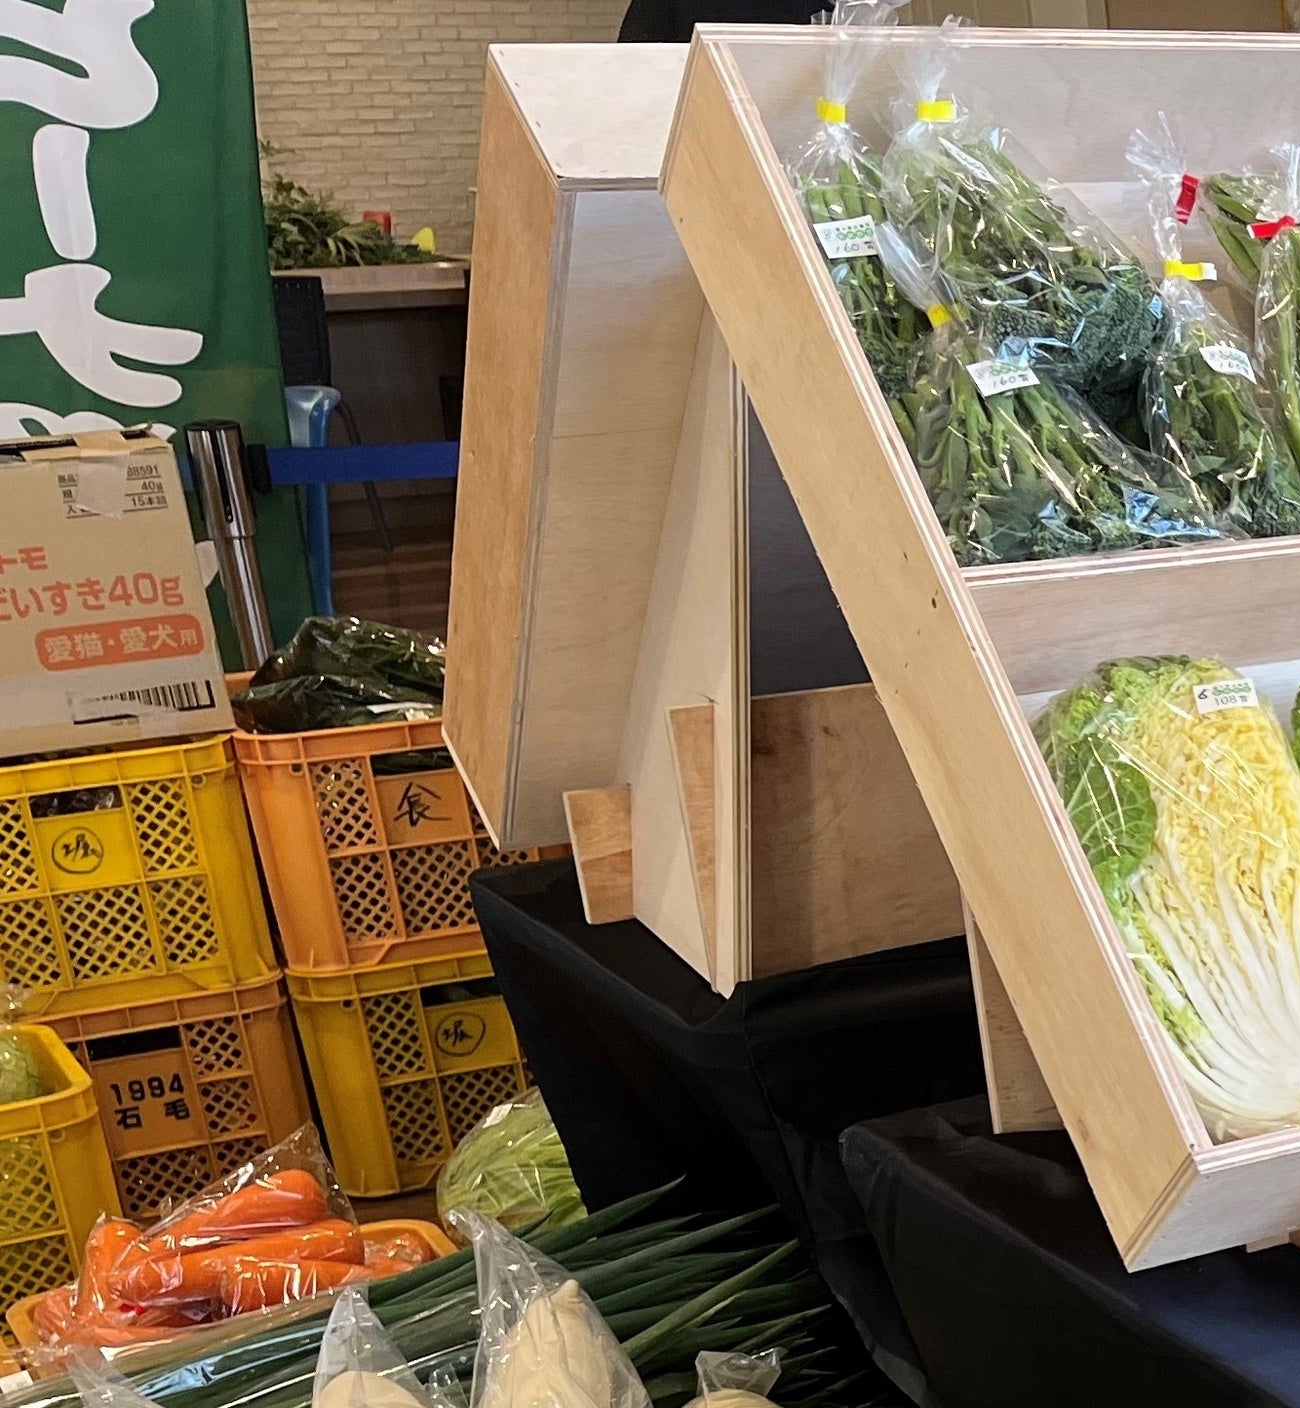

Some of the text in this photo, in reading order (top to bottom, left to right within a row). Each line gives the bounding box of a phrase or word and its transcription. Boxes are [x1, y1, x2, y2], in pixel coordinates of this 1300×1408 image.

[44, 623, 199, 664] 愛猫・愛犬用
[109, 1072, 185, 1101] 1994
[114, 1102, 192, 1130] 石毛
